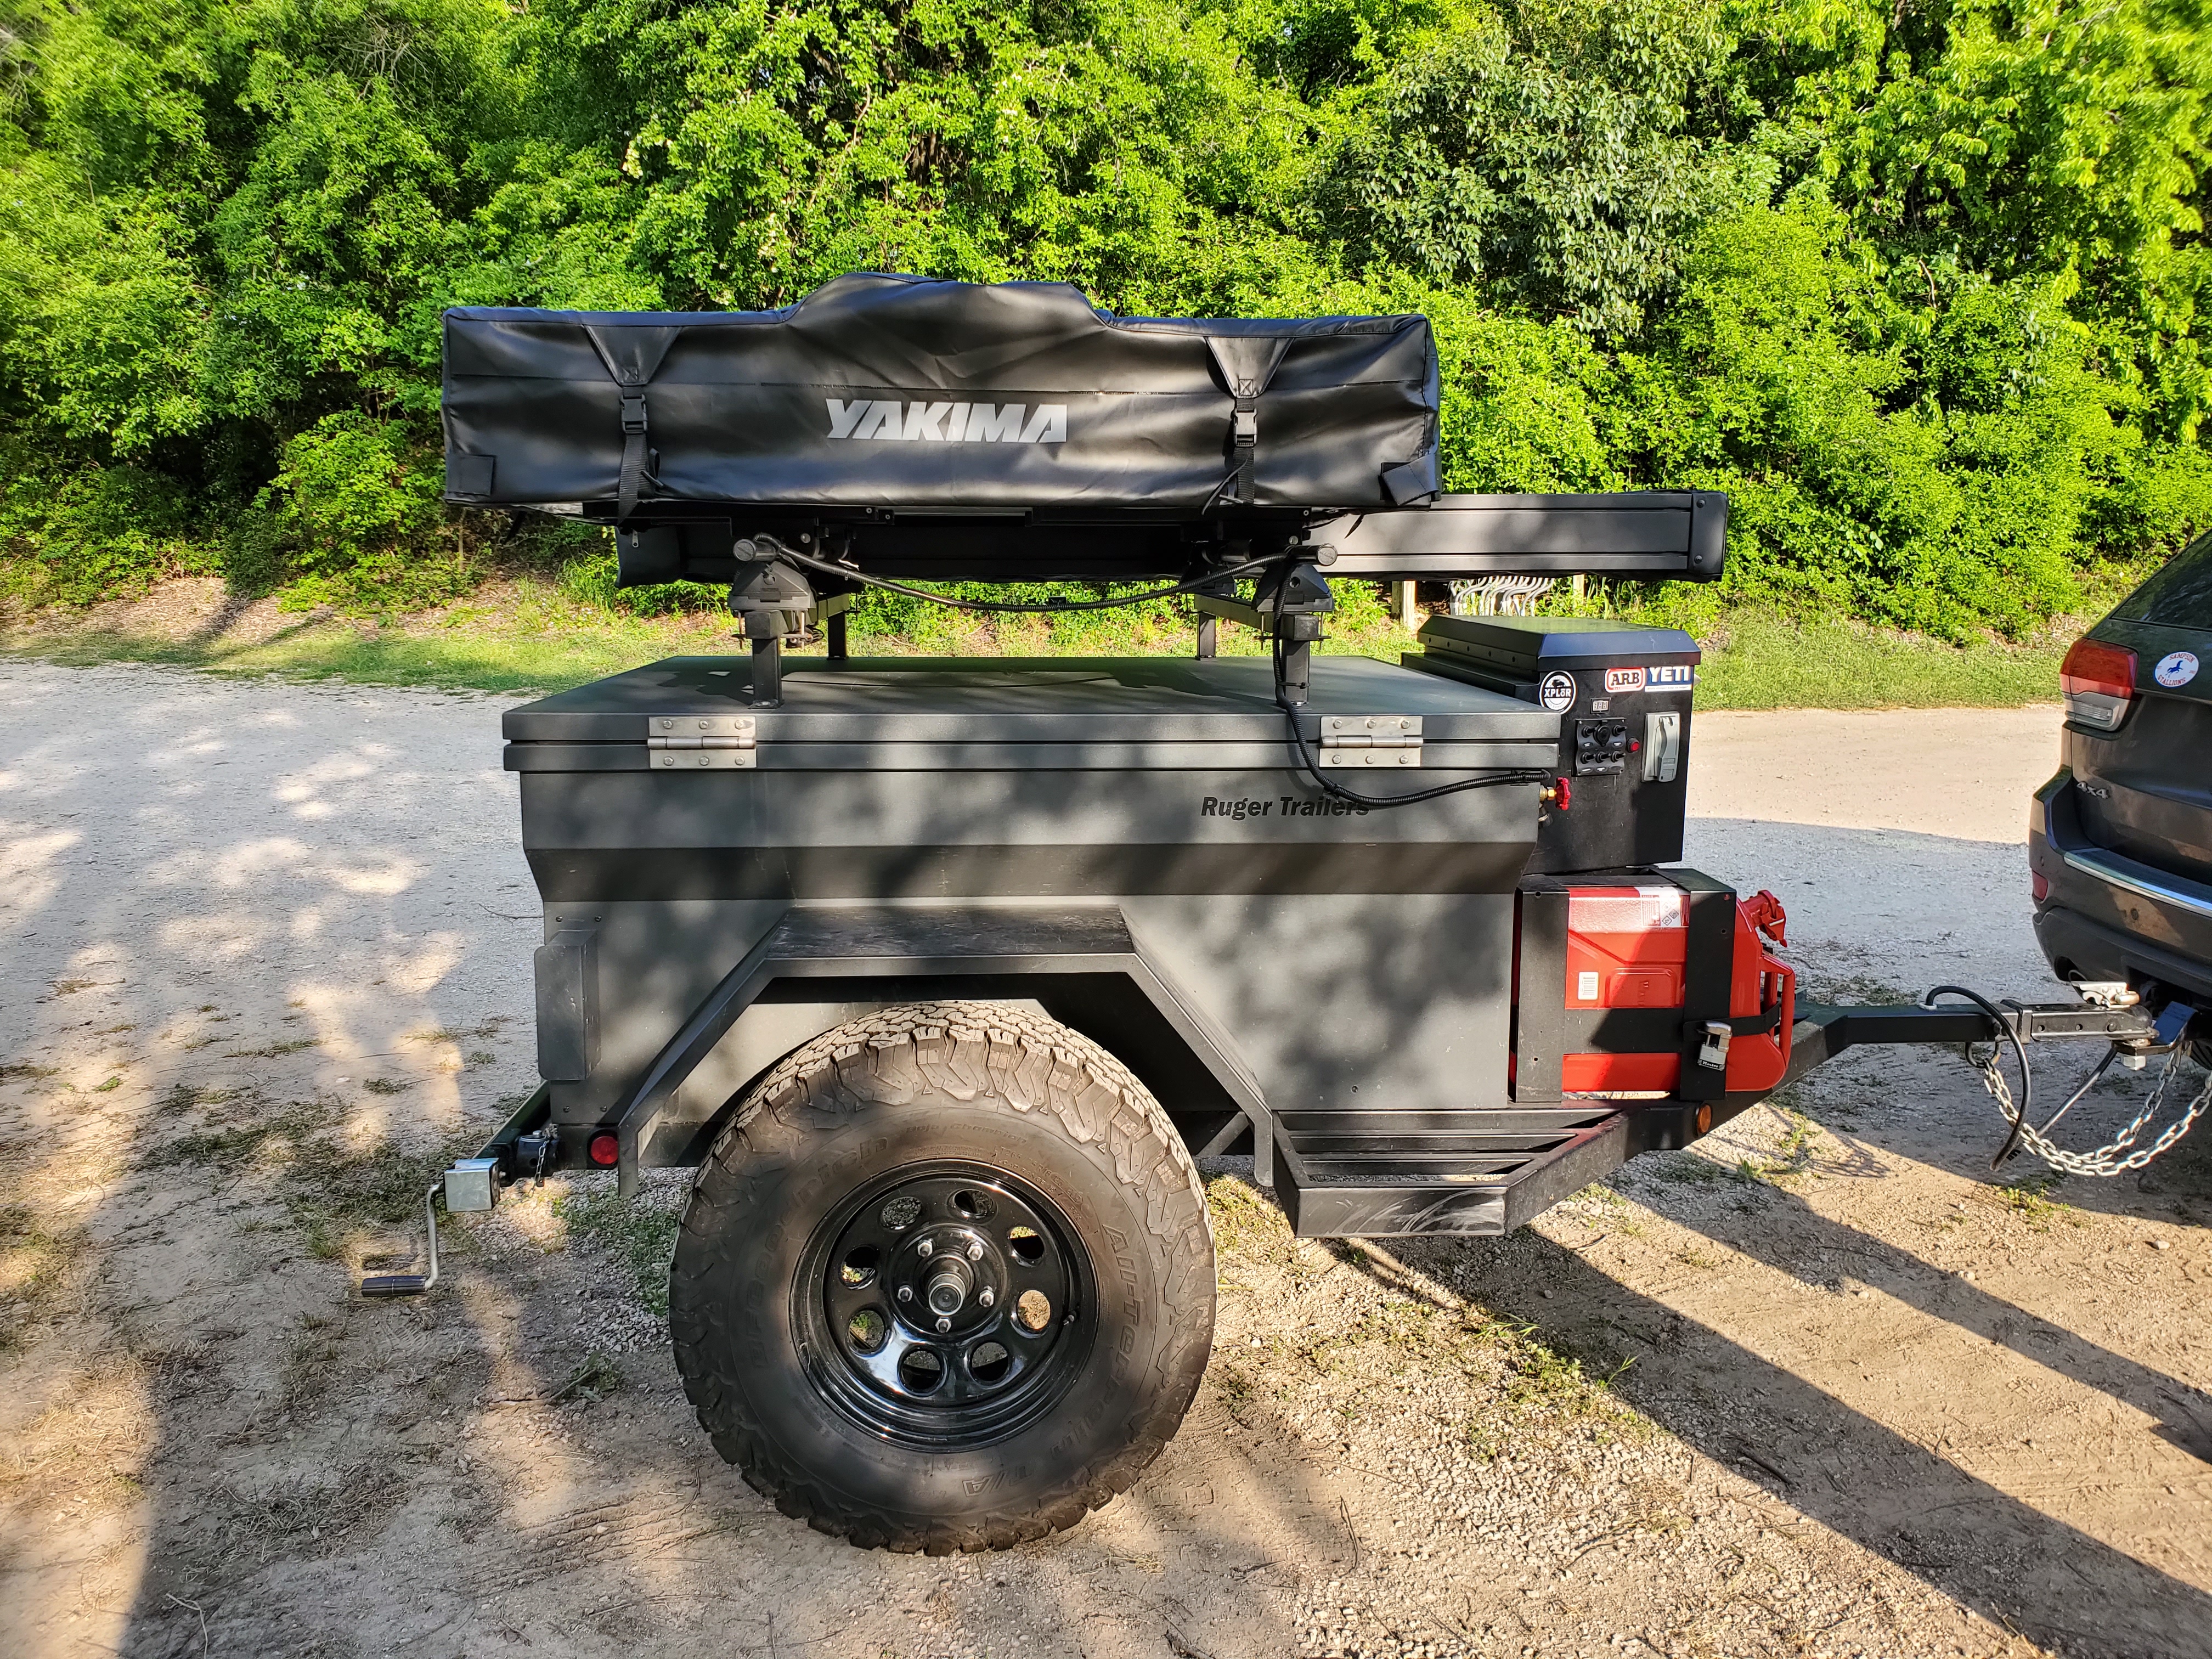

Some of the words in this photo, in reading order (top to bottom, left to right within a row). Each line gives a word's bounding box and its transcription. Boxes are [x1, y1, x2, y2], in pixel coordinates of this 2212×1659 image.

[826, 398, 1067, 443] YAKIMA
[2169, 653, 2195, 663] SAMPSON
[1611, 672, 1640, 686] ARB
[1649, 665, 1690, 682] YETI
[2158, 674, 2186, 686] STALLIONS
[1201, 797, 1272, 821] Ruger
[1280, 797, 1370, 816] Trailers
